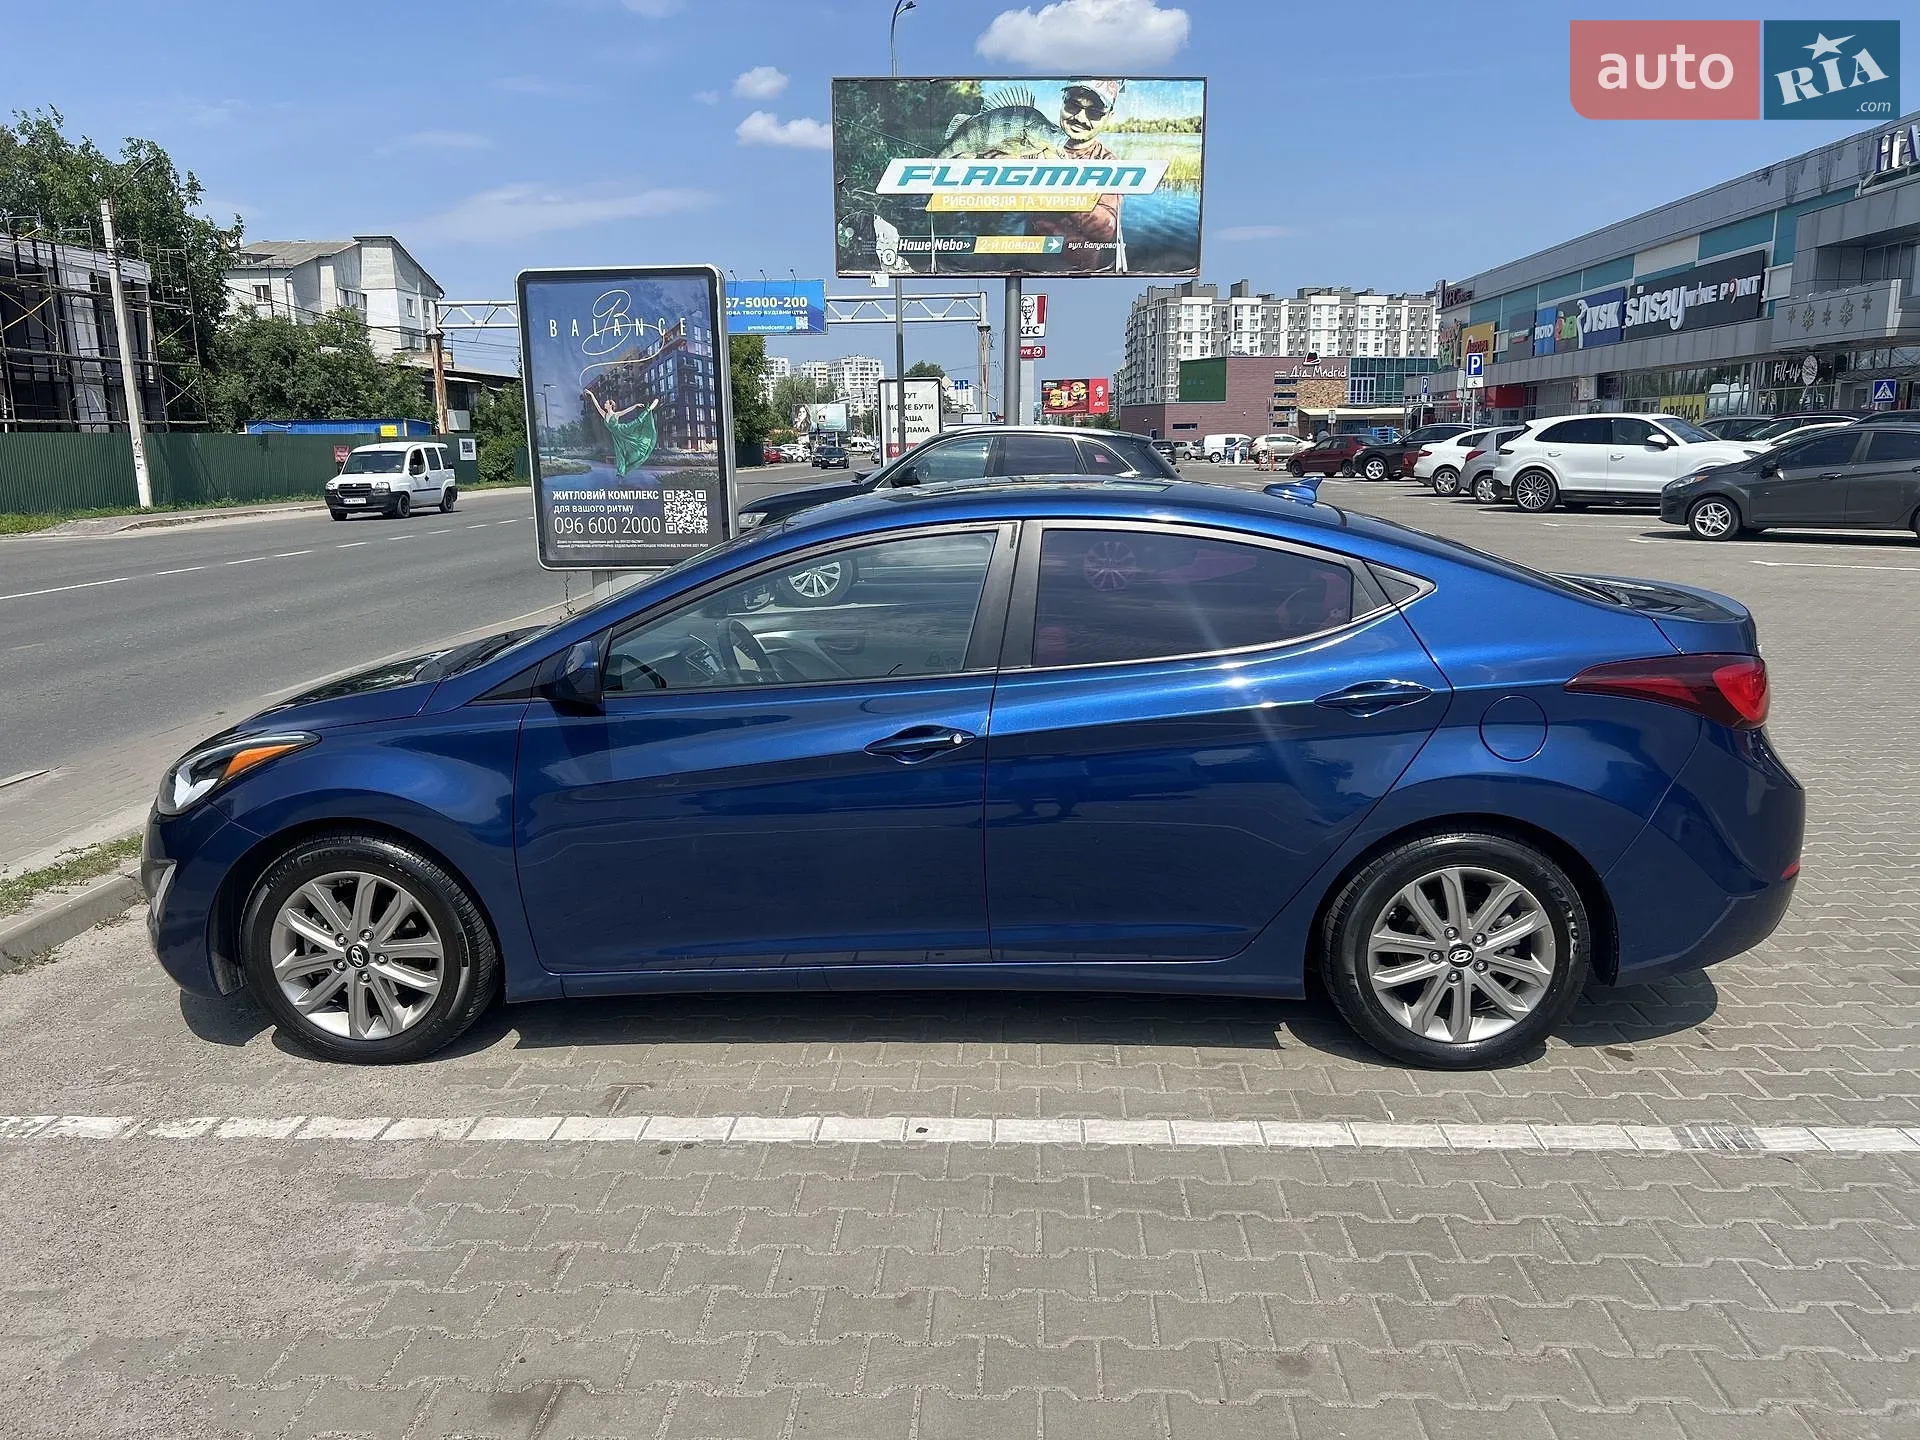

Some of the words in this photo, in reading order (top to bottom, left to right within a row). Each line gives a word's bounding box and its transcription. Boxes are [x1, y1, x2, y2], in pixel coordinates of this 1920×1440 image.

[897, 165, 1147, 187] FLAGMAN
[943, 194, 1017, 206] РИБОЛОВЛЯ
[1021, 194, 1036, 206] ТА
[1038, 194, 1087, 206] ТУРИЗМ
[1068, 241, 1083, 251] вул.
[1583, 300, 1621, 334] JYSK
[1625, 285, 1687, 331] sinsay
[549, 318, 687, 337] BALANCE
[1471, 356, 1480, 374] P
[914, 403, 934, 411] БУТИ
[553, 489, 606, 500] ЖИТЛОВИЙ
[608, 489, 660, 500] КОМПЛЕКС
[553, 505, 570, 514] для
[572, 505, 605, 513] вашого
[607, 504, 634, 514] ритму
[554, 516, 584, 534] 096
[588, 516, 617, 534] 600
[621, 516, 661, 534] 2000
